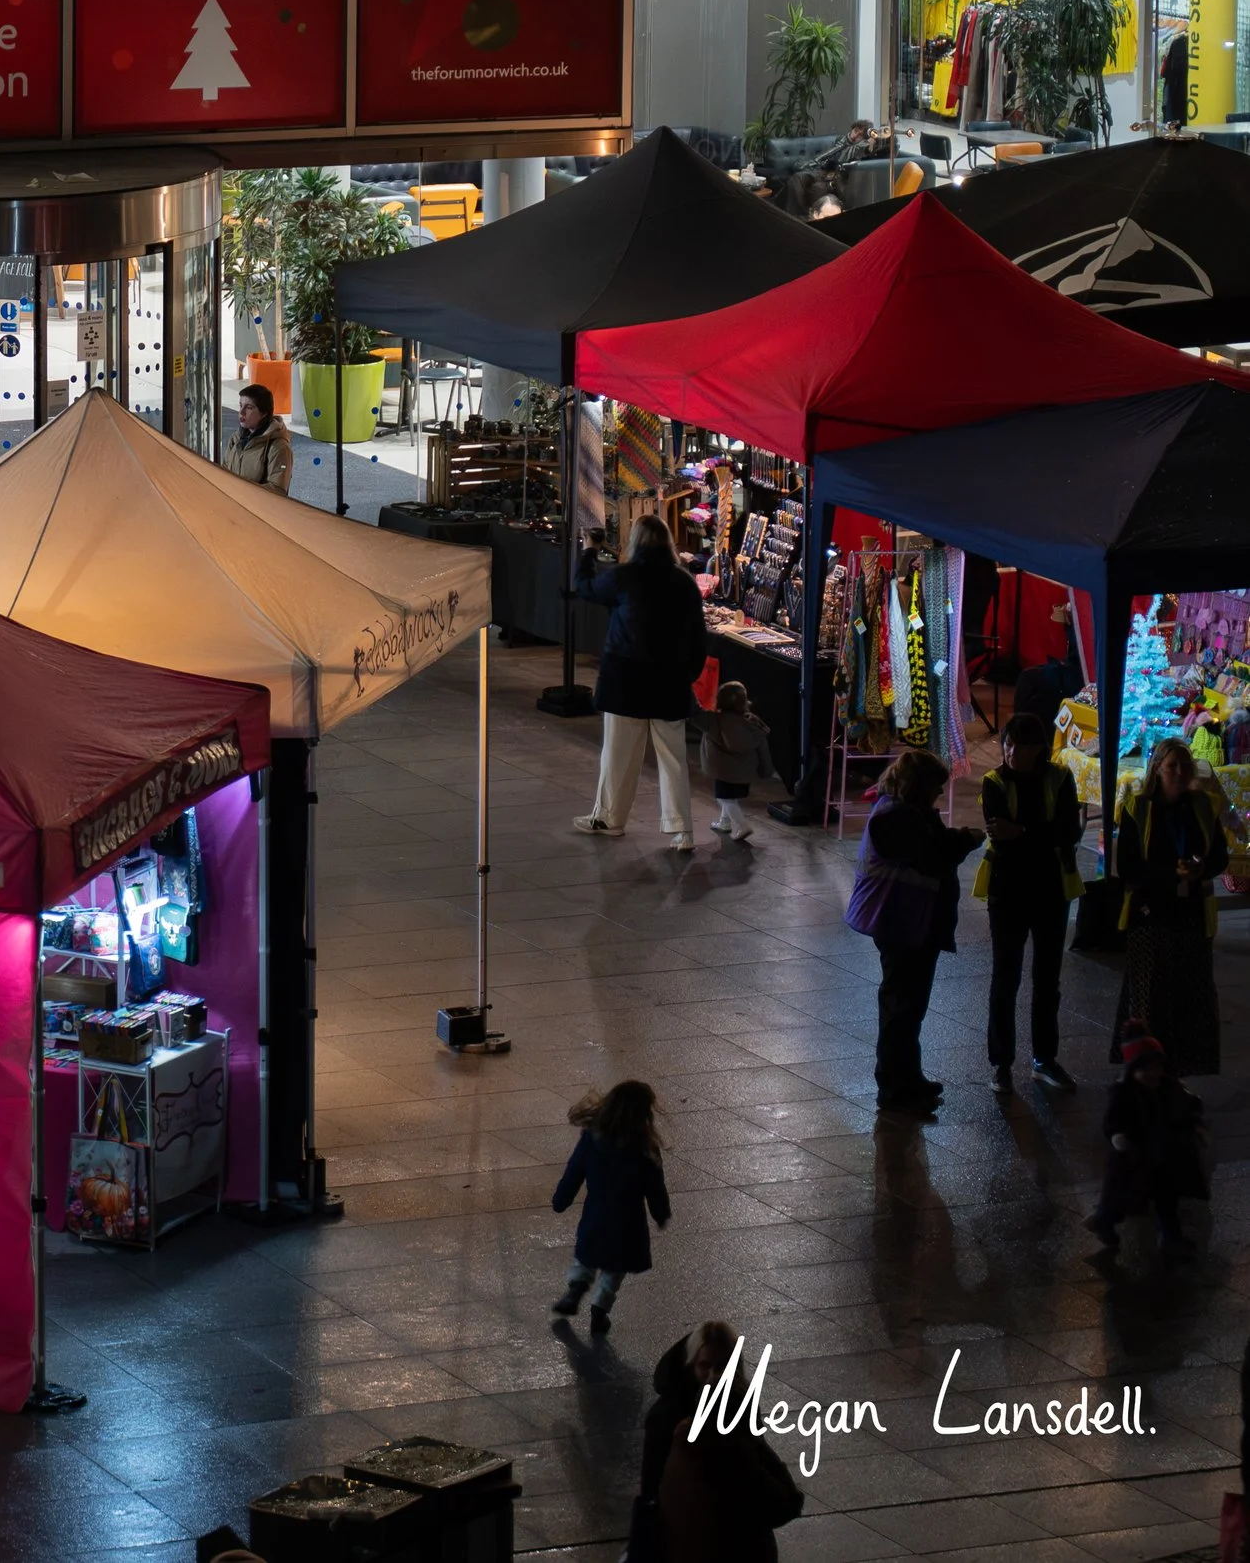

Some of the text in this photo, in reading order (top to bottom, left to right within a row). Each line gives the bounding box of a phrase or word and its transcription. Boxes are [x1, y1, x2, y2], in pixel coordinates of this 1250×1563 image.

[411, 61, 569, 81] theforumnorwich.co.uk
[1188, 33, 1201, 71] The
[1187, 83, 1199, 121] On
